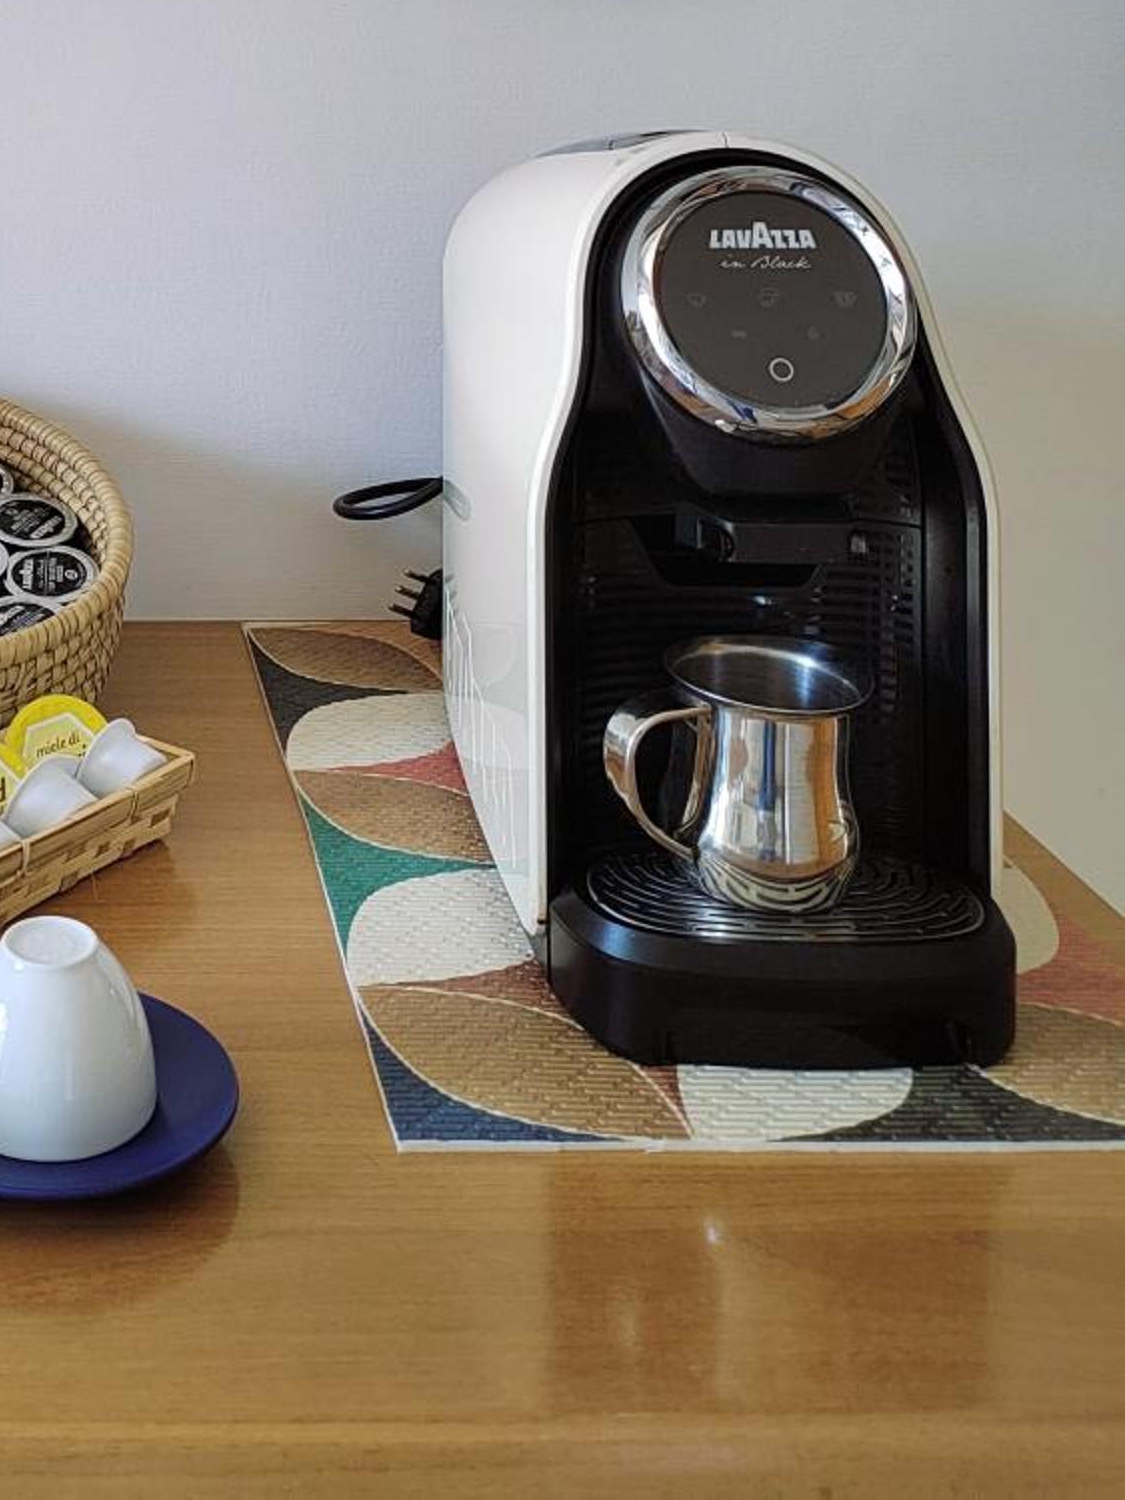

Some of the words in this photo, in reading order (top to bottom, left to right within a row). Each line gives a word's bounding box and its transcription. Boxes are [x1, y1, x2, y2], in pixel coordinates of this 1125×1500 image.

[709, 221, 817, 249] LAVAZZA
[35, 735, 67, 758] miele
[68, 731, 81, 747] di
